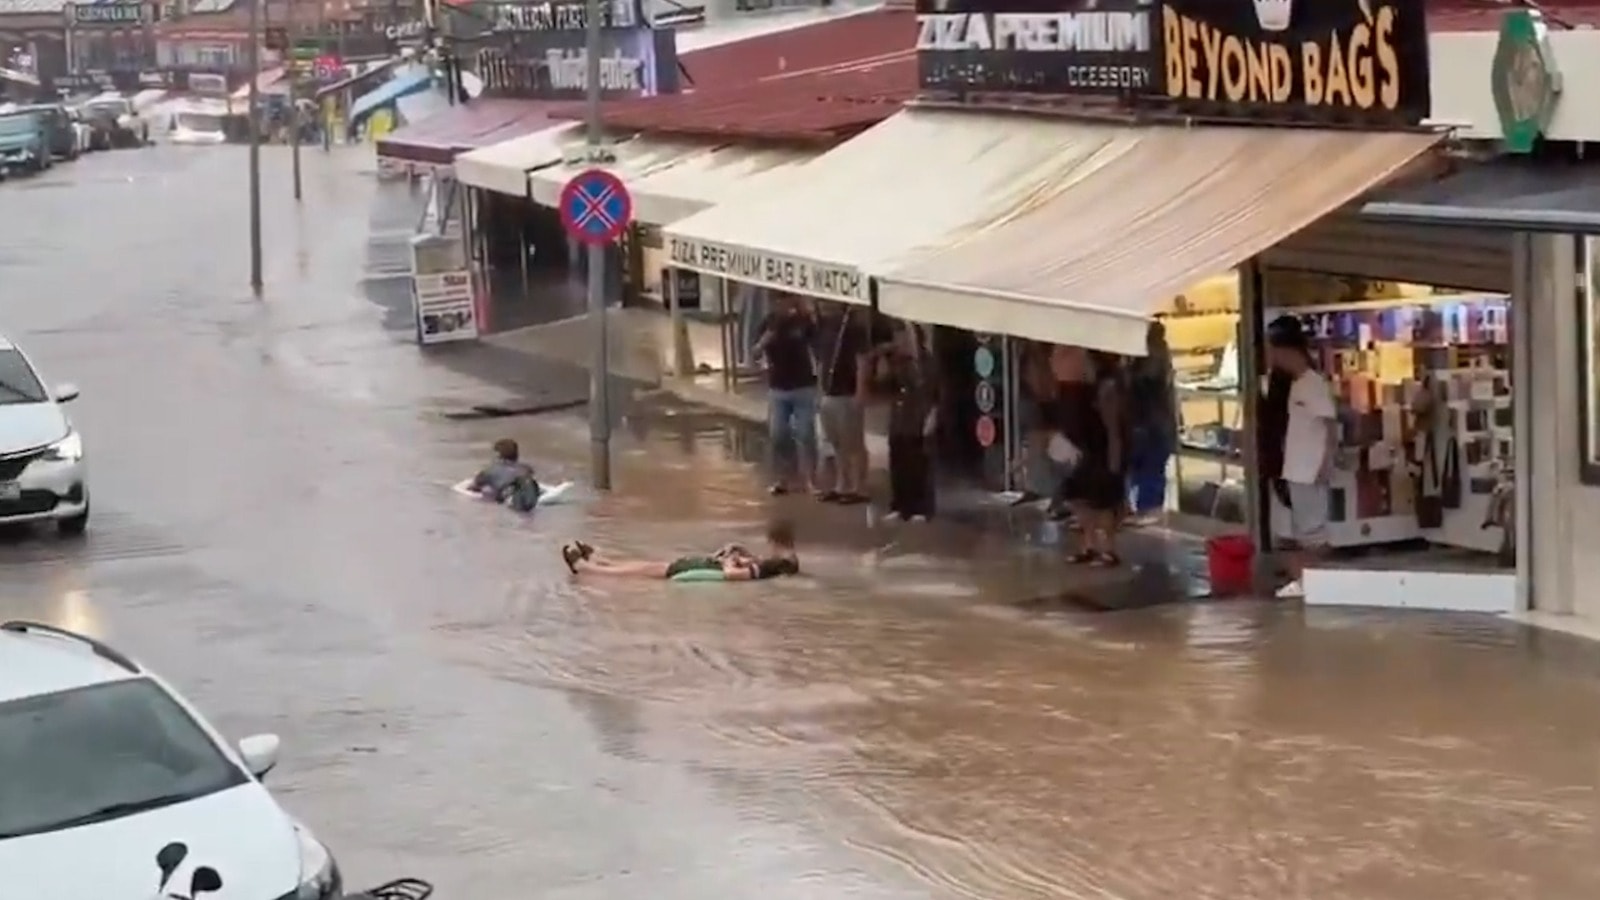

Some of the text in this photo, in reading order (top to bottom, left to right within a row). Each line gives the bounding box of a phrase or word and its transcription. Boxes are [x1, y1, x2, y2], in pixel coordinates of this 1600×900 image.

[915, 11, 1151, 52] ZIZA PREMIUM
[1163, 6, 1291, 100] BEYOND
[1303, 1, 1400, 110] BAG'S
[671, 239, 697, 263] ZIZA
[701, 245, 761, 276] PREMIUM
[799, 264, 808, 288] &
[812, 268, 861, 297] WATCH
